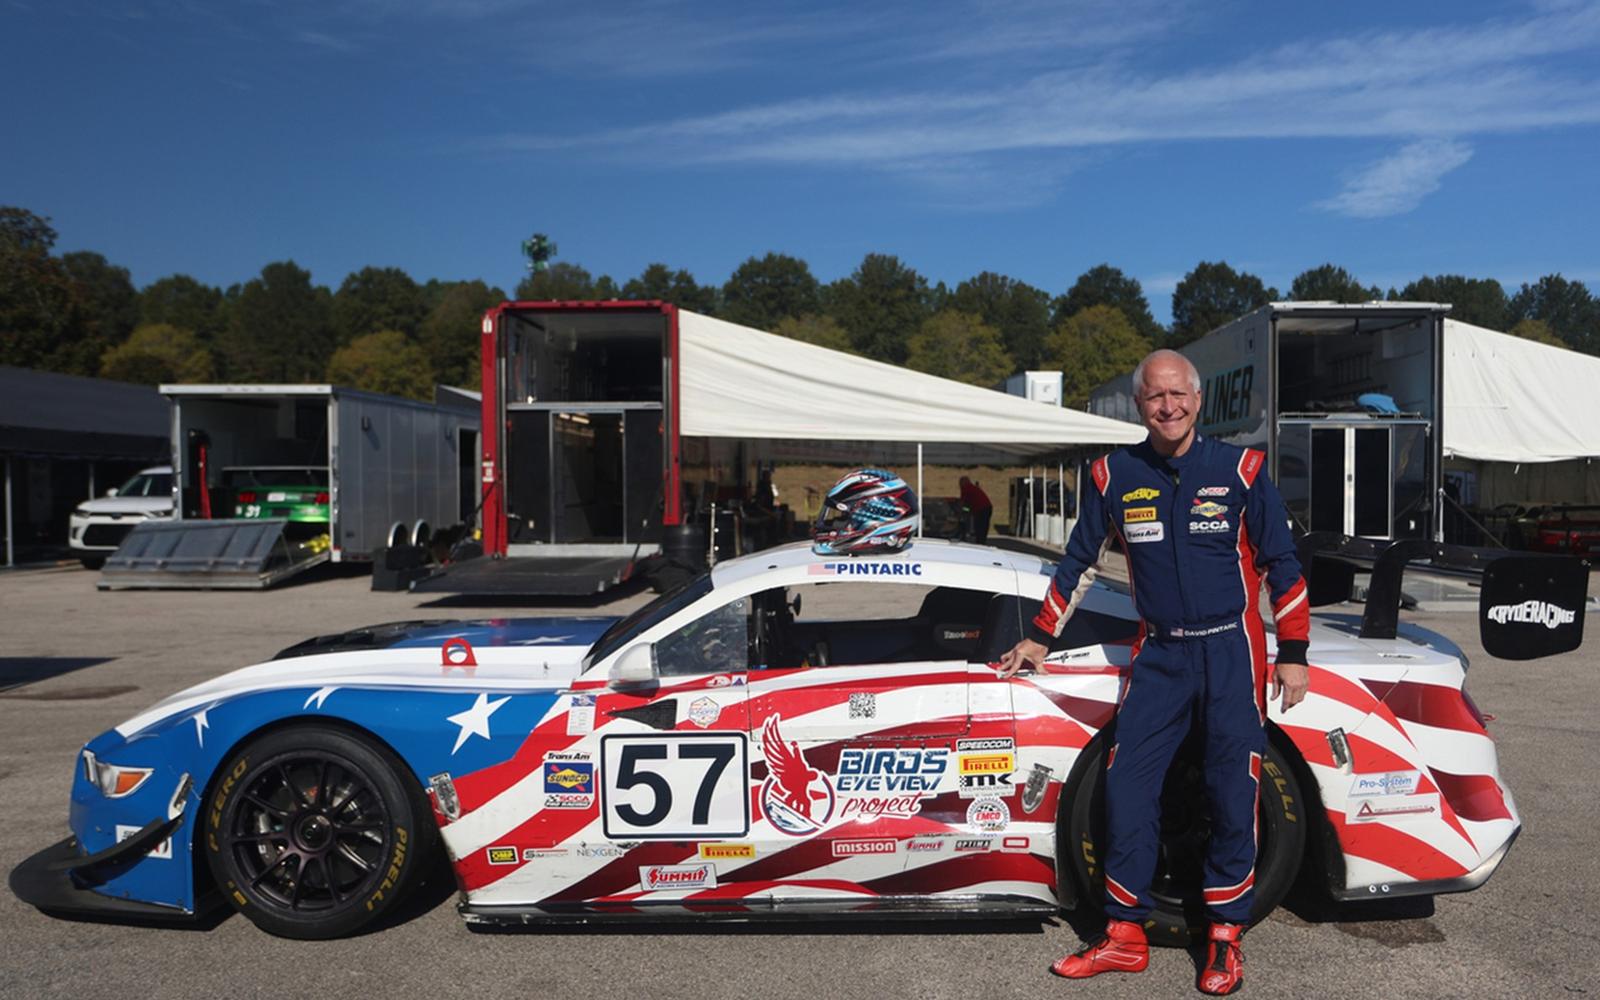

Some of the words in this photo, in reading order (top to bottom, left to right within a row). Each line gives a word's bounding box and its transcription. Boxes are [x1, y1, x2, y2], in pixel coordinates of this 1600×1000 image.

[1189, 520, 1230, 531] SCCA
[837, 563, 922, 576] PINTARIC
[1184, 629, 1208, 637] DAVID
[959, 741, 1012, 751] SPEEDCOM
[547, 752, 573, 760] Trans
[574, 752, 591, 760] Am
[839, 750, 949, 775] BIRDS
[963, 756, 1009, 771] PIRELLI
[547, 774, 590, 783] SUNOCO
[836, 776, 883, 791] EYE
[885, 776, 943, 791] VIEW
[1359, 777, 1413, 790] Pro-System
[615, 743, 736, 828] 57
[211, 758, 248, 830] ZERO
[840, 792, 923, 818] project
[976, 811, 1001, 821] EMCO
[955, 839, 991, 848] OPTIMA
[576, 848, 622, 857] NEXGEN
[705, 846, 750, 857] PIRELLI
[366, 826, 408, 912] PIRELLI
